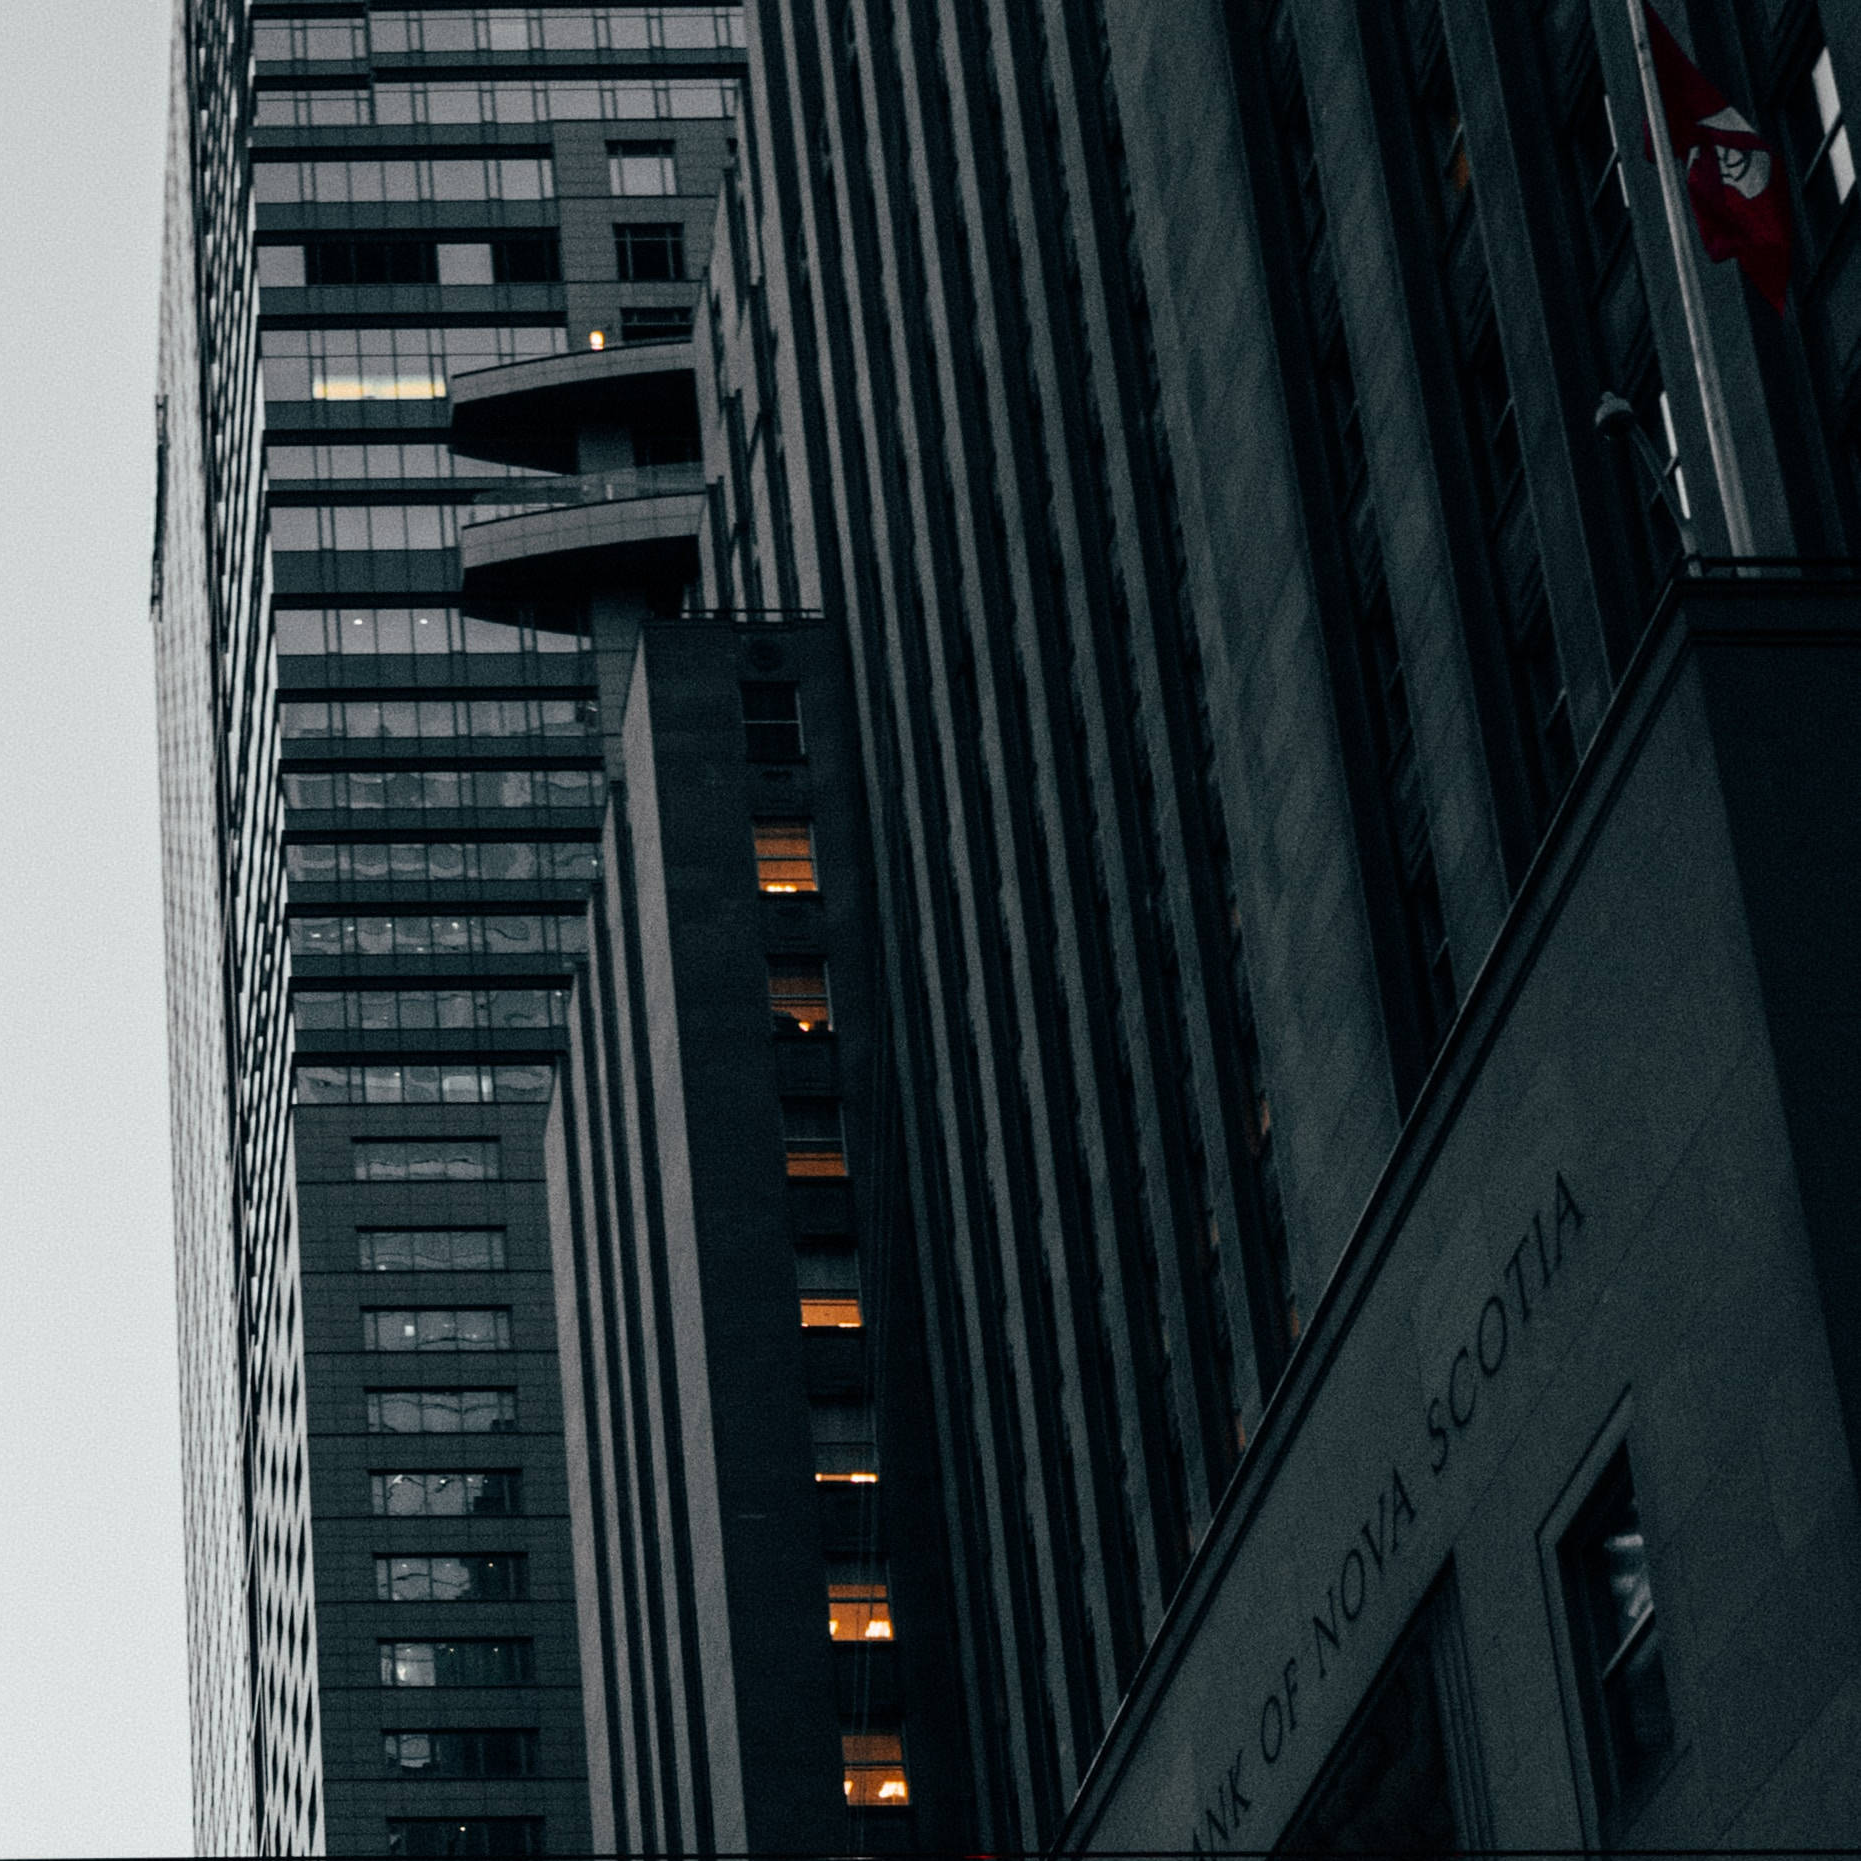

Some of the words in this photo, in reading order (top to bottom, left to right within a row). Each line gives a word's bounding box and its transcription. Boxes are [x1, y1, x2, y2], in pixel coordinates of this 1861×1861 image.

[1260, 1657, 1299, 1764] OF
[1312, 1467, 1416, 1679] NOVA
[1427, 1170, 1586, 1474] SCOTIA
